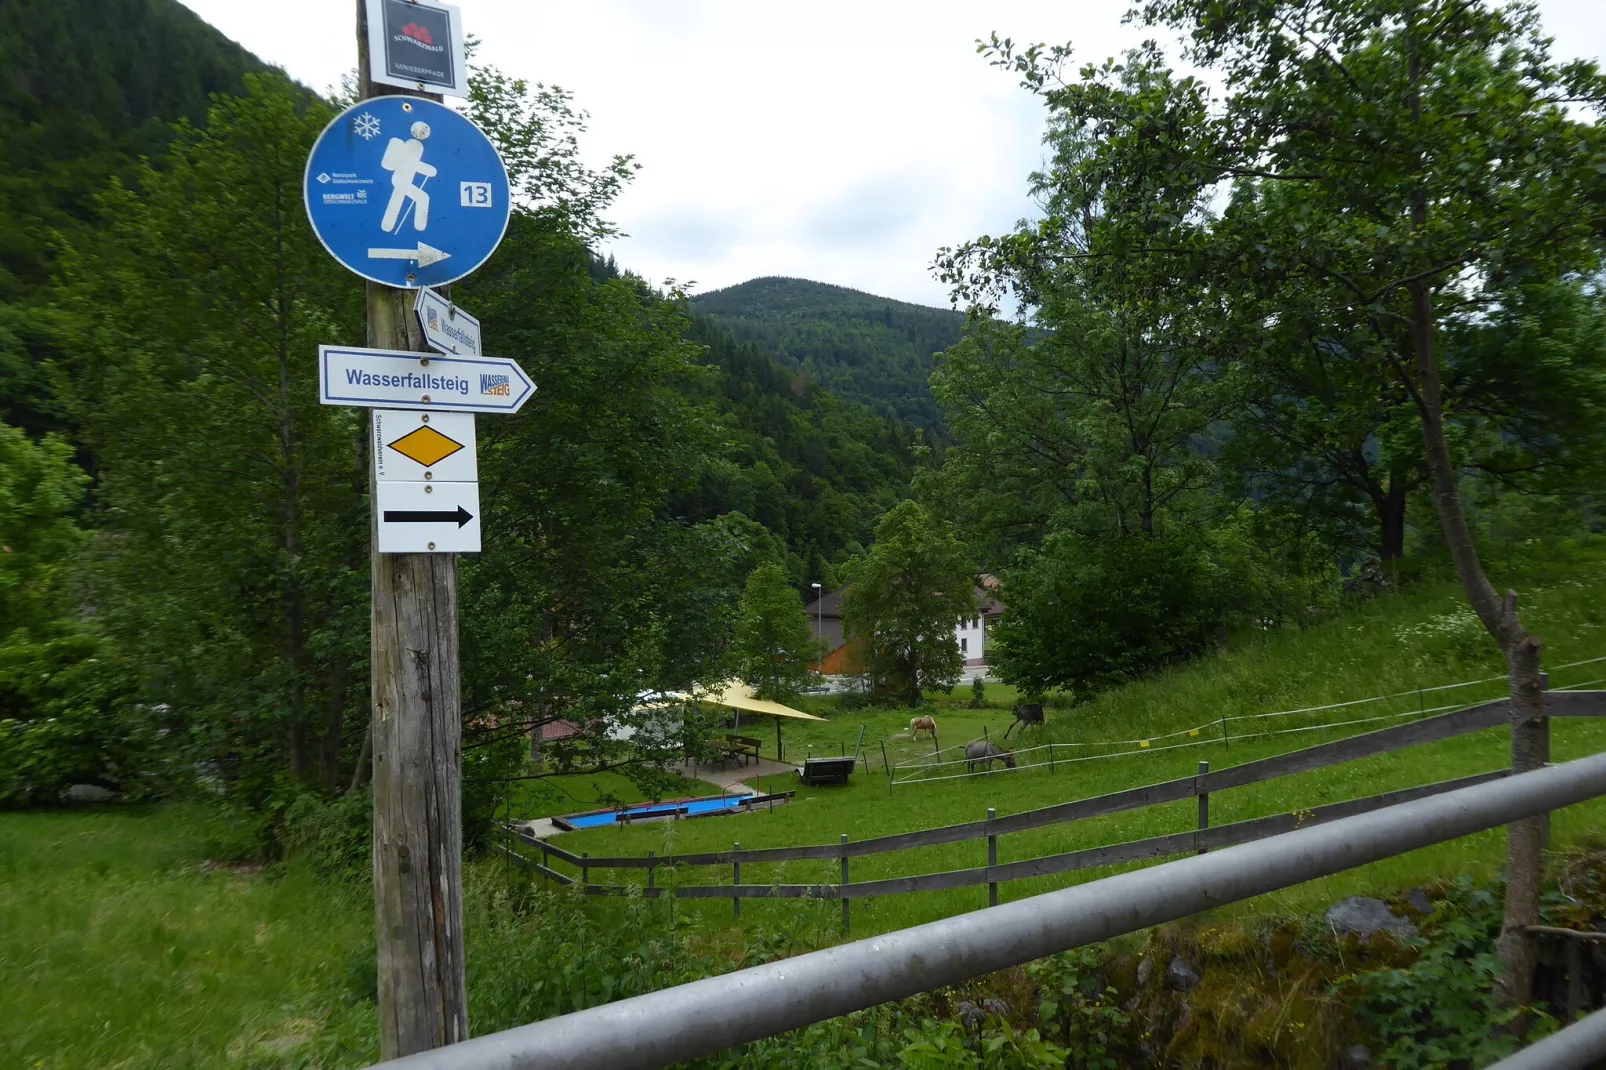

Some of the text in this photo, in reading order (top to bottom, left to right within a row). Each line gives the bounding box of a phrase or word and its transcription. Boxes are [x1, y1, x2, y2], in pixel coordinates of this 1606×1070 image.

[393, 34, 444, 52] SCHWARZWALD
[464, 185, 488, 203] 13
[440, 316, 476, 354] Wasserfallsteig
[345, 368, 469, 395] Wasserfallsteig
[375, 414, 384, 465] Schwarzwaldverein
